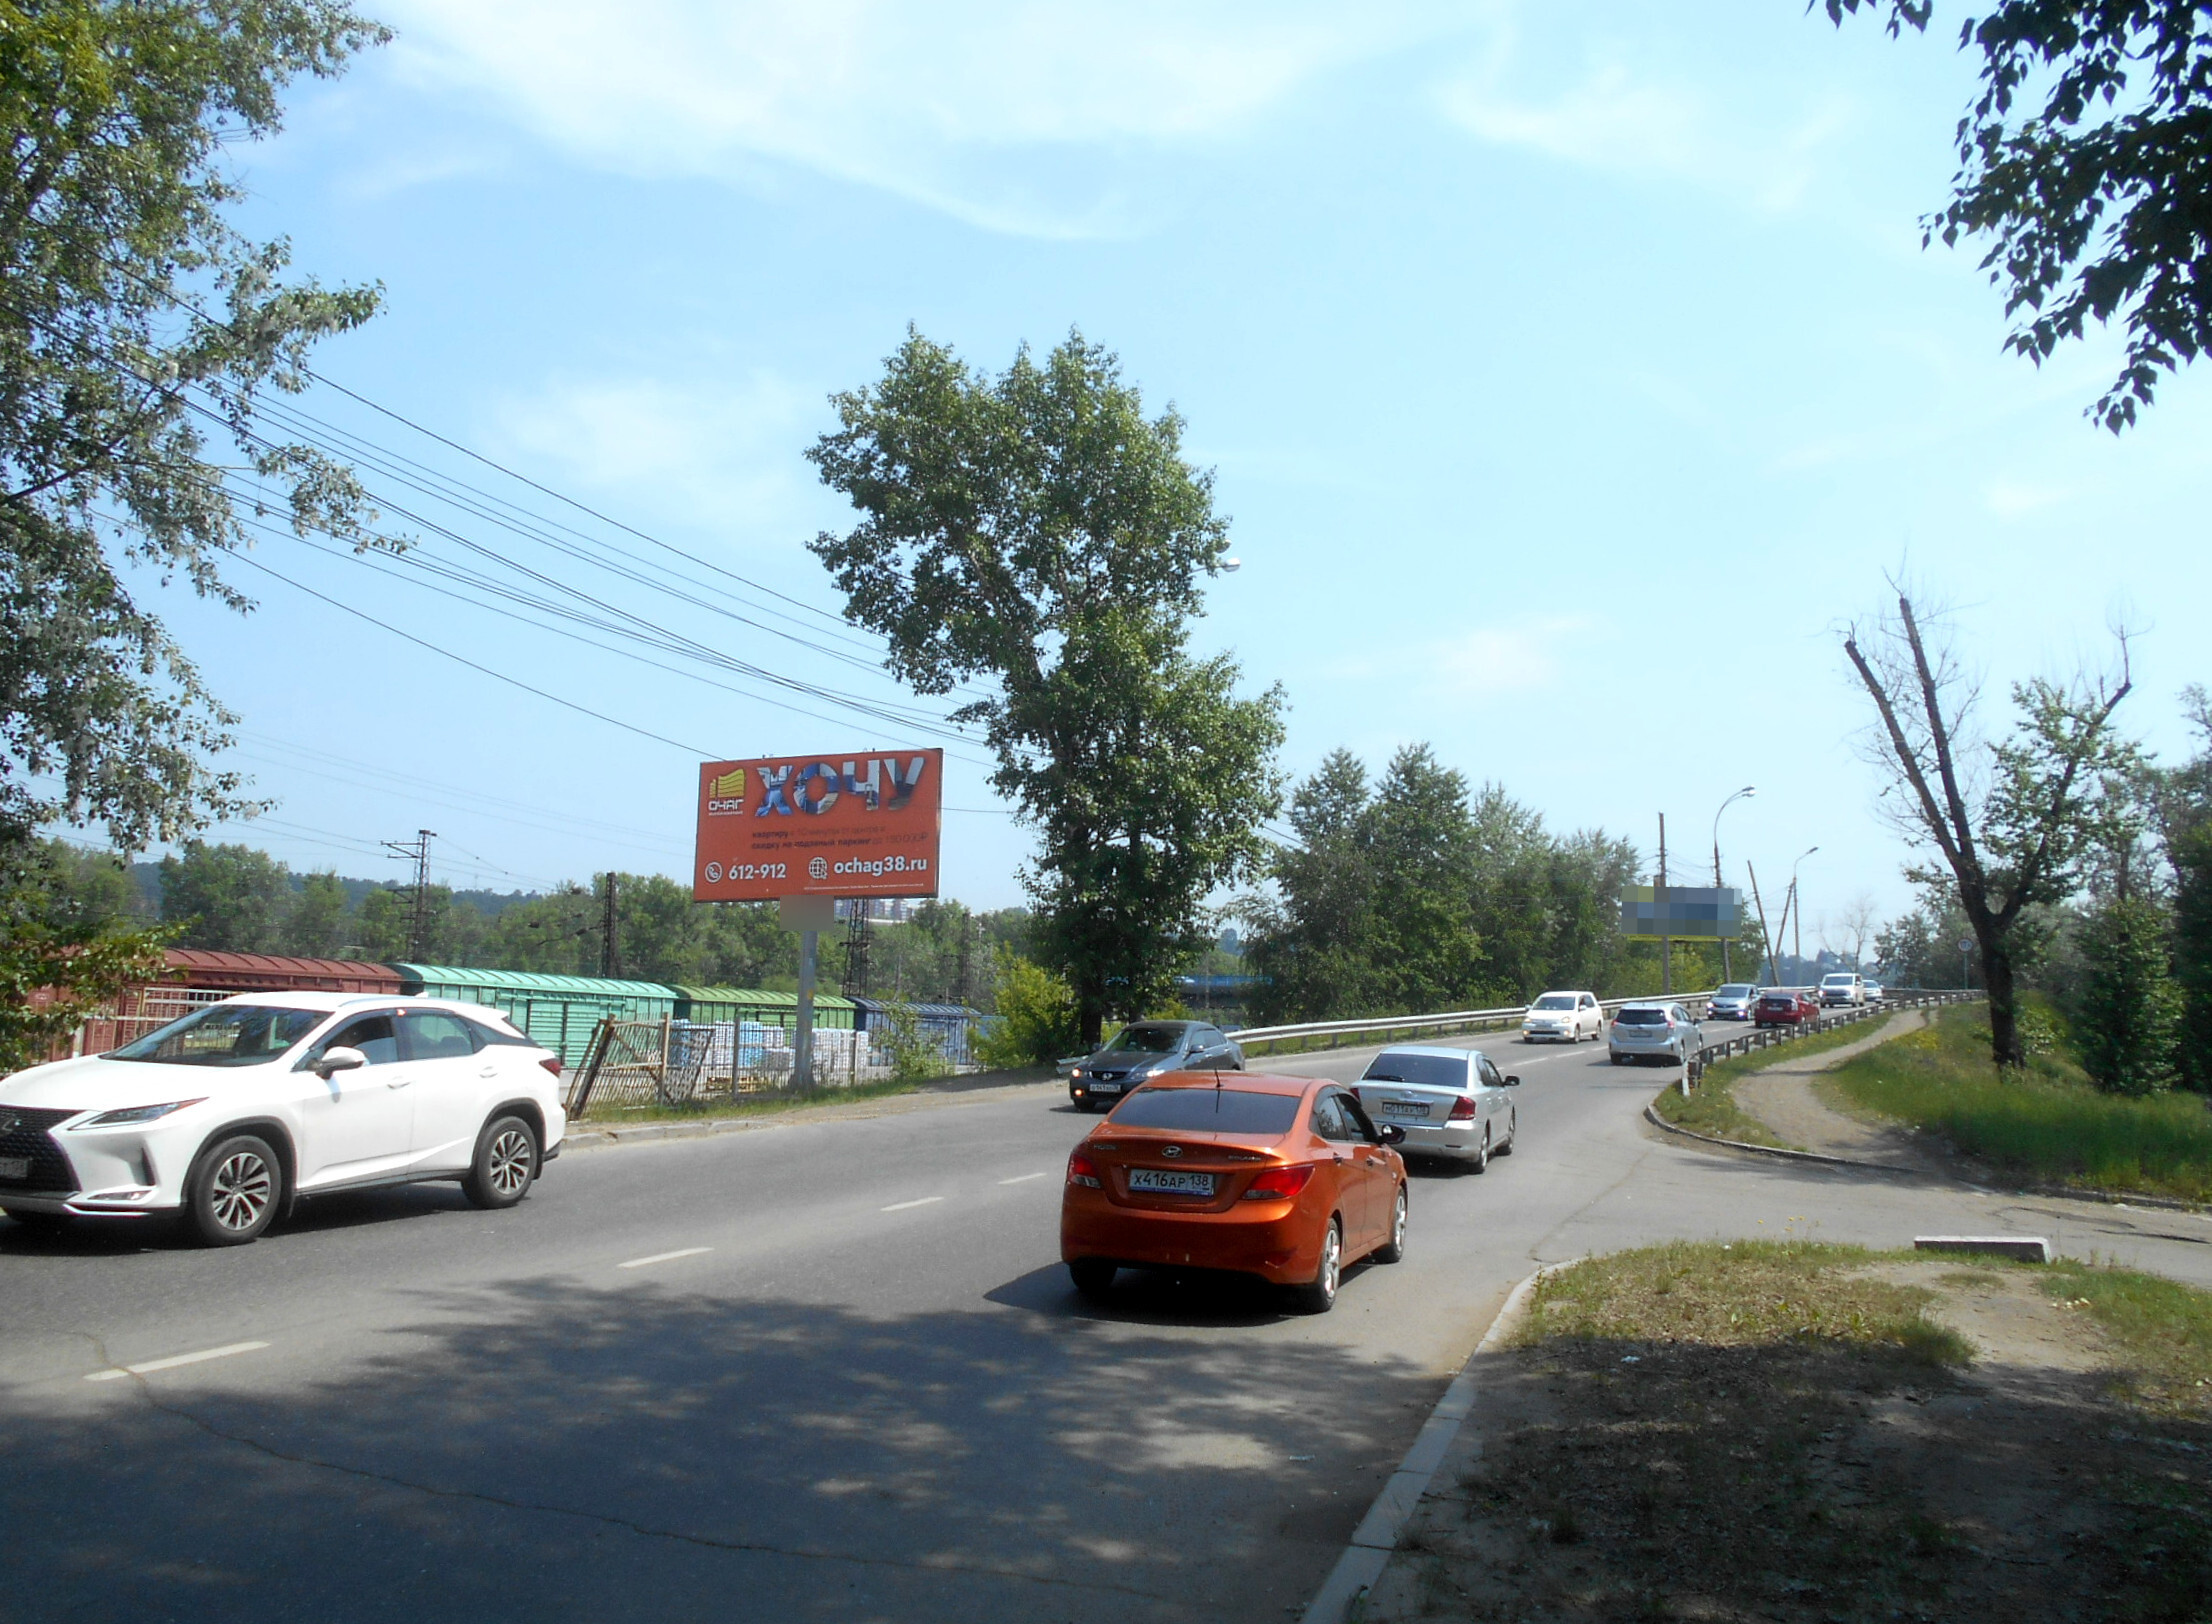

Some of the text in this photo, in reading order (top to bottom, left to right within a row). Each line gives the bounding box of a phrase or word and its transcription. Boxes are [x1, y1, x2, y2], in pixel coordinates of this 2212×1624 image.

[754, 757, 925, 817] ХОЧУ
[708, 798, 744, 812] ОЧАГ
[728, 863, 787, 880] 612-912
[833, 855, 928, 877] ochag38.ru
